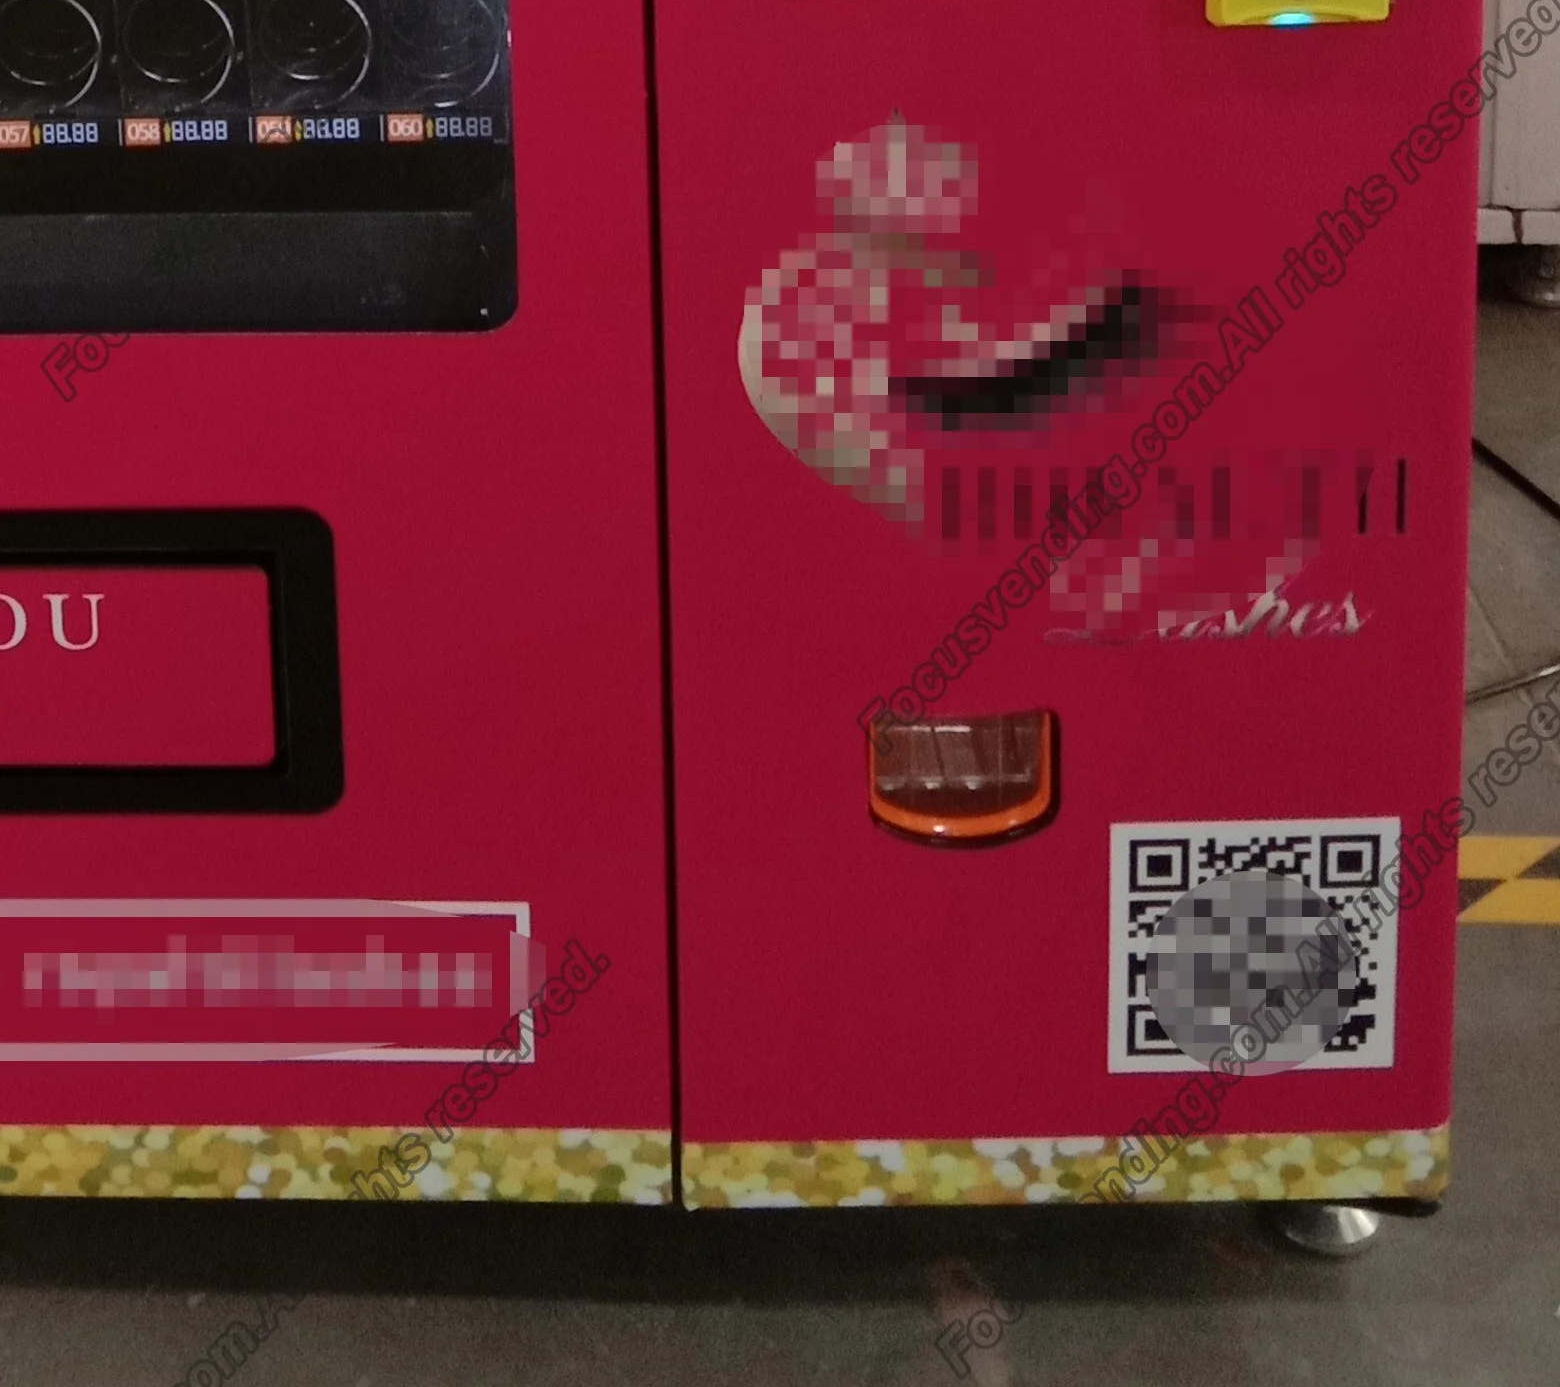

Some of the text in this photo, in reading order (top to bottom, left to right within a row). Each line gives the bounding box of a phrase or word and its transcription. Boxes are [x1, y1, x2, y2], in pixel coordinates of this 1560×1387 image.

[42, 120, 98, 144] 88.88
[127, 119, 228, 142] 058 88.88
[388, 115, 492, 138] 060 88.88
